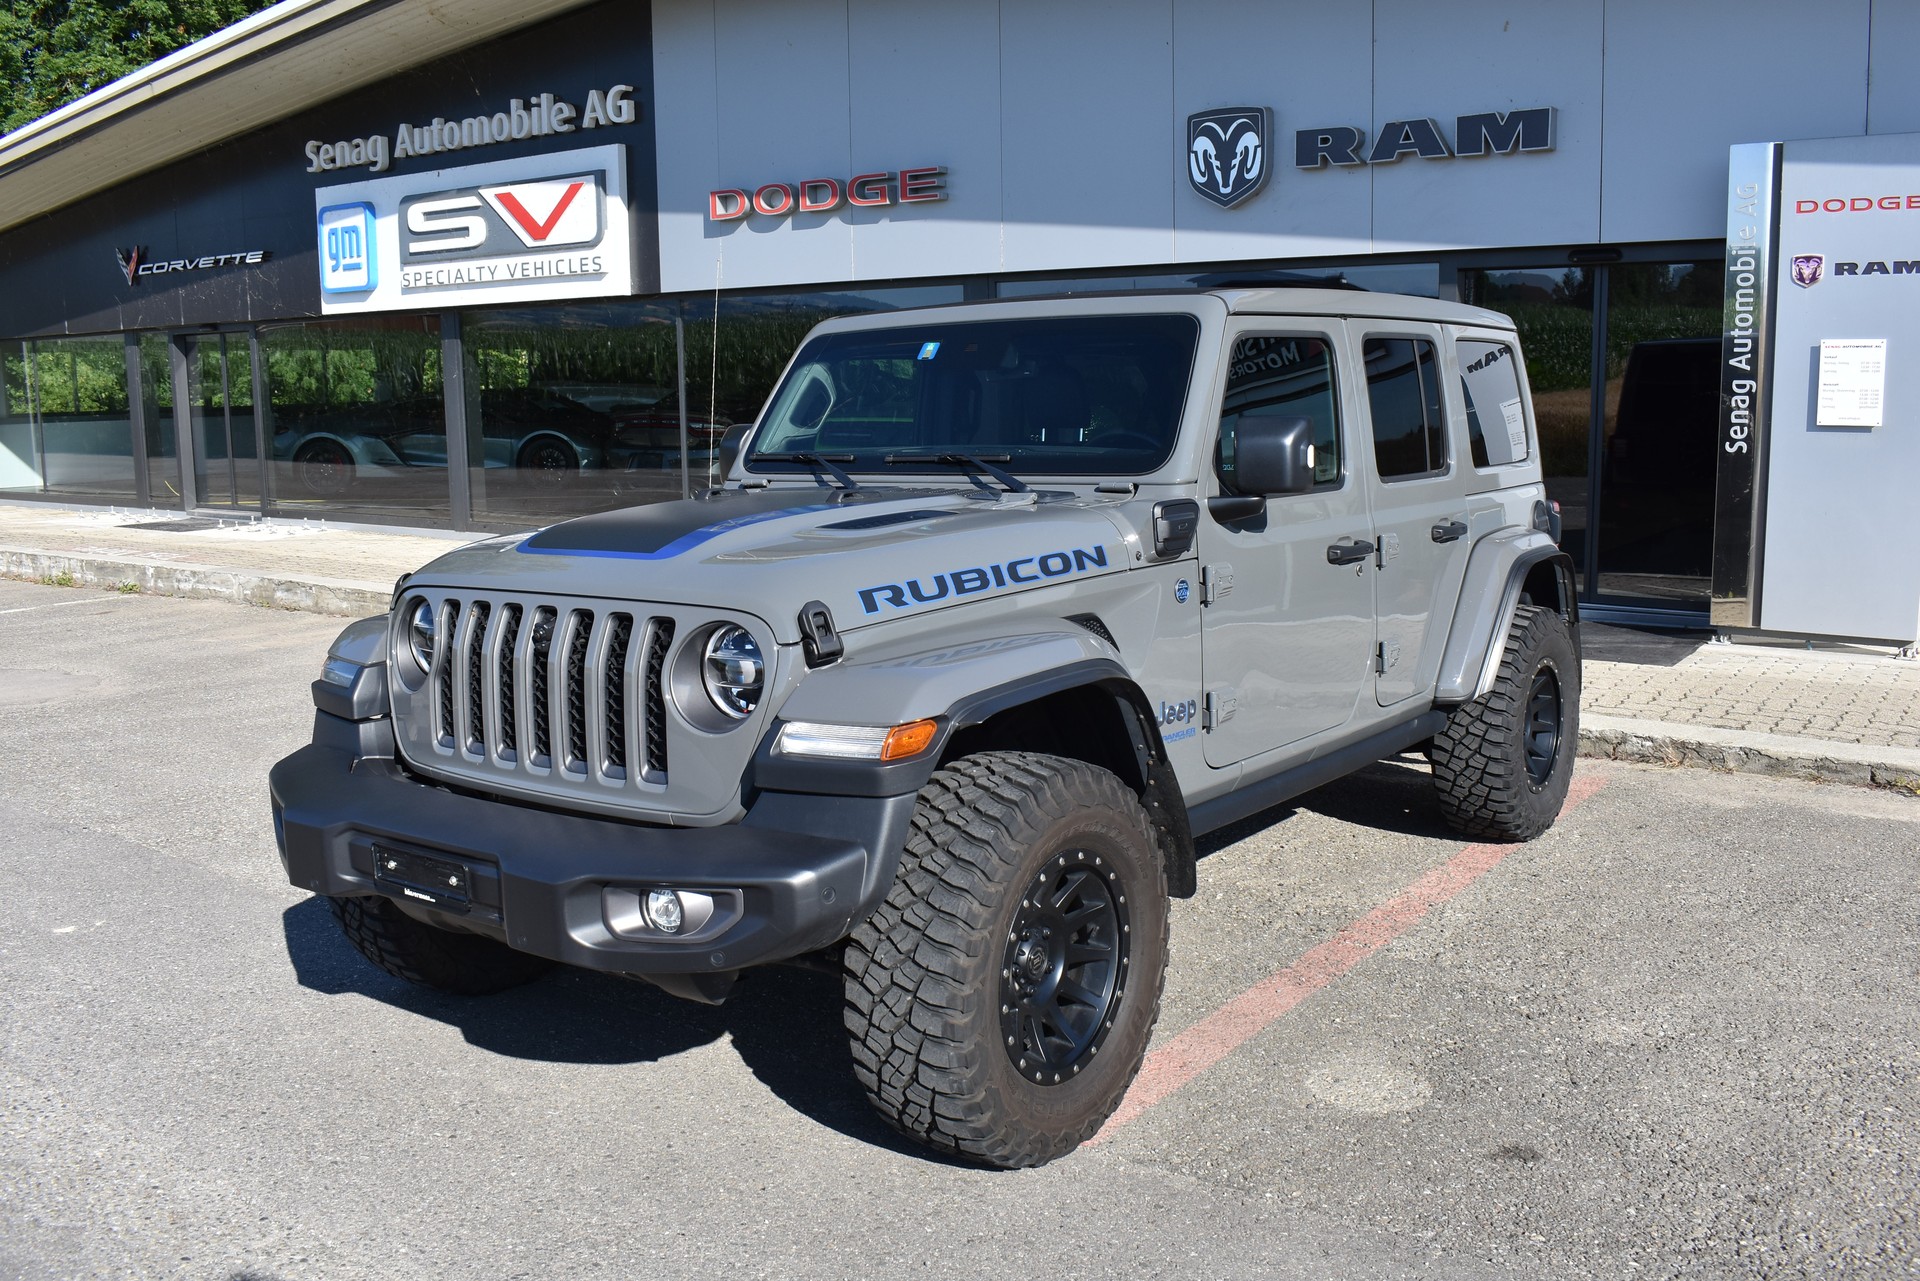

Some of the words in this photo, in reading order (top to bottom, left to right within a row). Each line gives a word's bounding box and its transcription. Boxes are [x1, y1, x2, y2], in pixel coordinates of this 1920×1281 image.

[305, 135, 389, 173] Senag
[394, 93, 576, 158] Automobile
[582, 84, 635, 129] AG
[1295, 106, 1557, 170] RAM
[709, 166, 948, 222] DODGE
[1736, 183, 1758, 217] AG
[1795, 195, 1920, 214] DODGE
[138, 250, 265, 276] CORVETTE
[327, 225, 362, 272] gm
[402, 264, 499, 288] SPECIALTY
[507, 256, 603, 278] VEHICLES
[1834, 260, 1920, 276] RAM
[1728, 225, 1757, 371] Automobile
[1724, 378, 1757, 455] Senag
[857, 544, 1109, 615] RUBICON
[1156, 699, 1197, 728] Jeep
